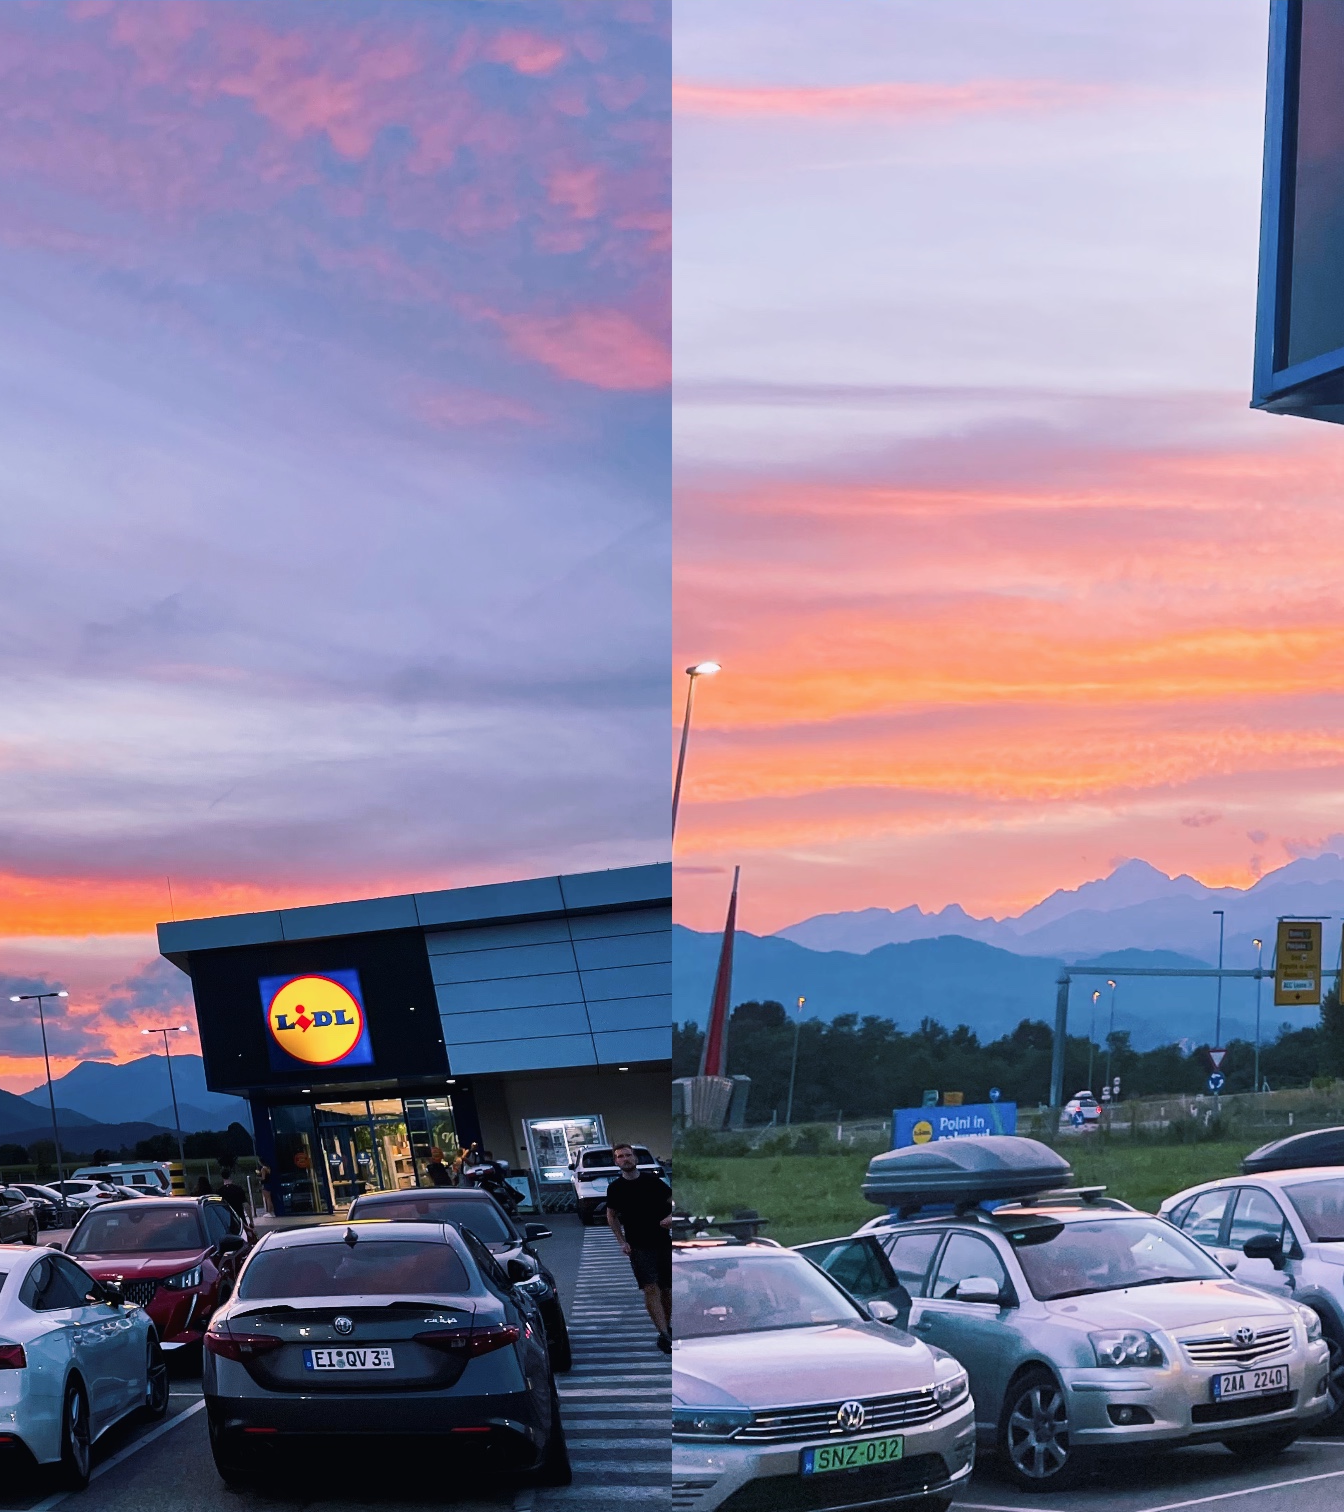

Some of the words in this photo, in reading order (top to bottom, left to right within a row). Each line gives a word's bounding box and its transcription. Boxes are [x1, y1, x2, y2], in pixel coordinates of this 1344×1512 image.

[939, 1116, 971, 1131] Polni
[973, 1115, 985, 1128] in
[314, 1351, 336, 1368] EI
[345, 1350, 367, 1368] QV
[371, 1350, 382, 1367] 3
[1223, 1375, 1245, 1393] 2AA
[1254, 1369, 1283, 1388] 2240
[818, 1439, 899, 1469] SNZ-032
